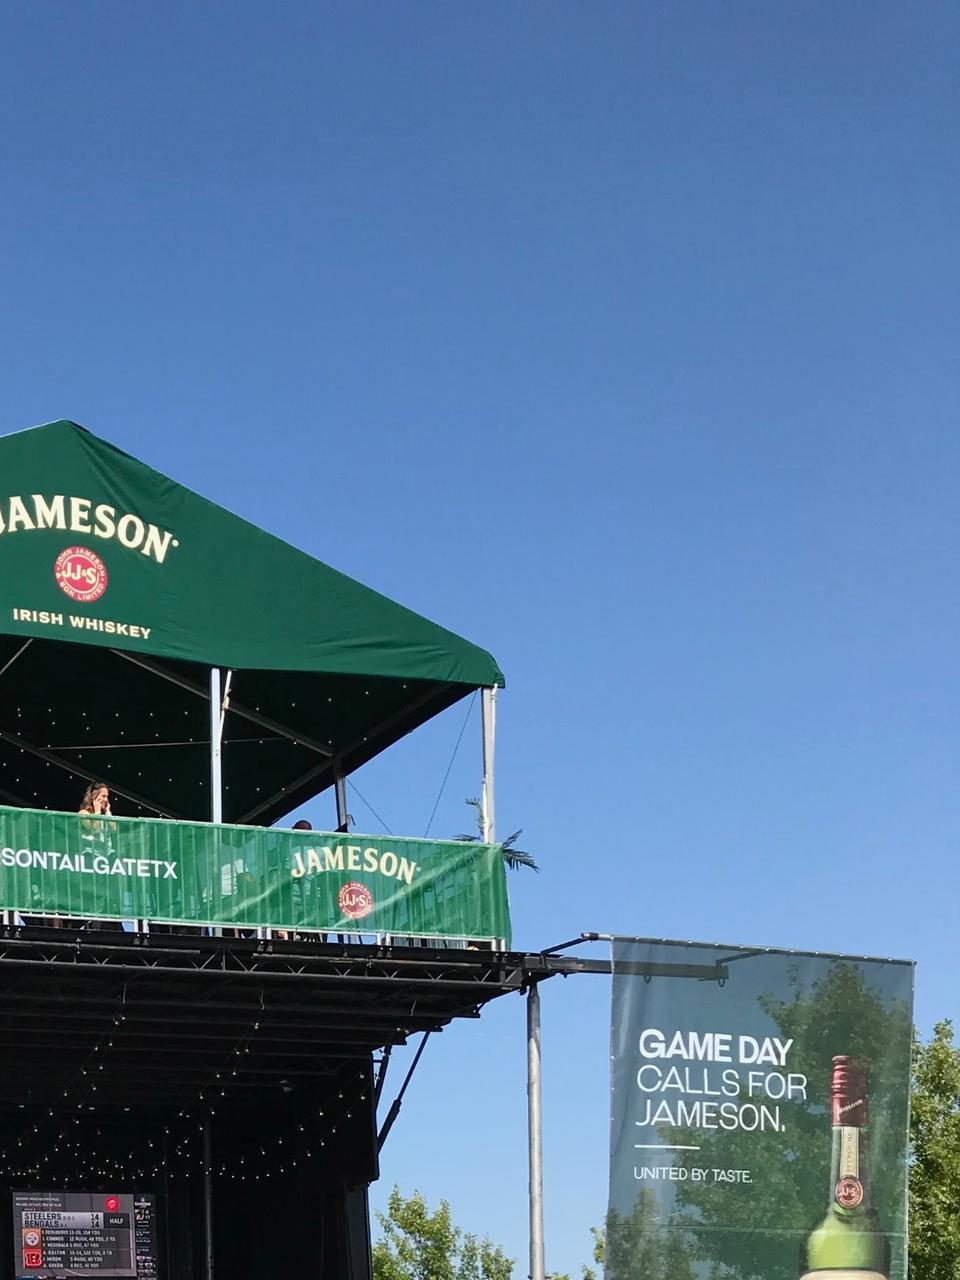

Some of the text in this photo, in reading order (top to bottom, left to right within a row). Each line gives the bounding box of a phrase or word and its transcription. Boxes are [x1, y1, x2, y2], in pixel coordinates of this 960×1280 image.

[13, 608, 151, 640] IRISH WHISKEY
[291, 845, 417, 884] JAMESON
[640, 1029, 794, 1066] GAME DAY
[637, 1064, 807, 1100] CALLS FOR
[635, 1099, 786, 1132] JAMESON.
[634, 1166, 753, 1184] UNITED BY TASTE.
[24, 1212, 62, 1221] STEELERS
[24, 1220, 59, 1228] BENGALS
